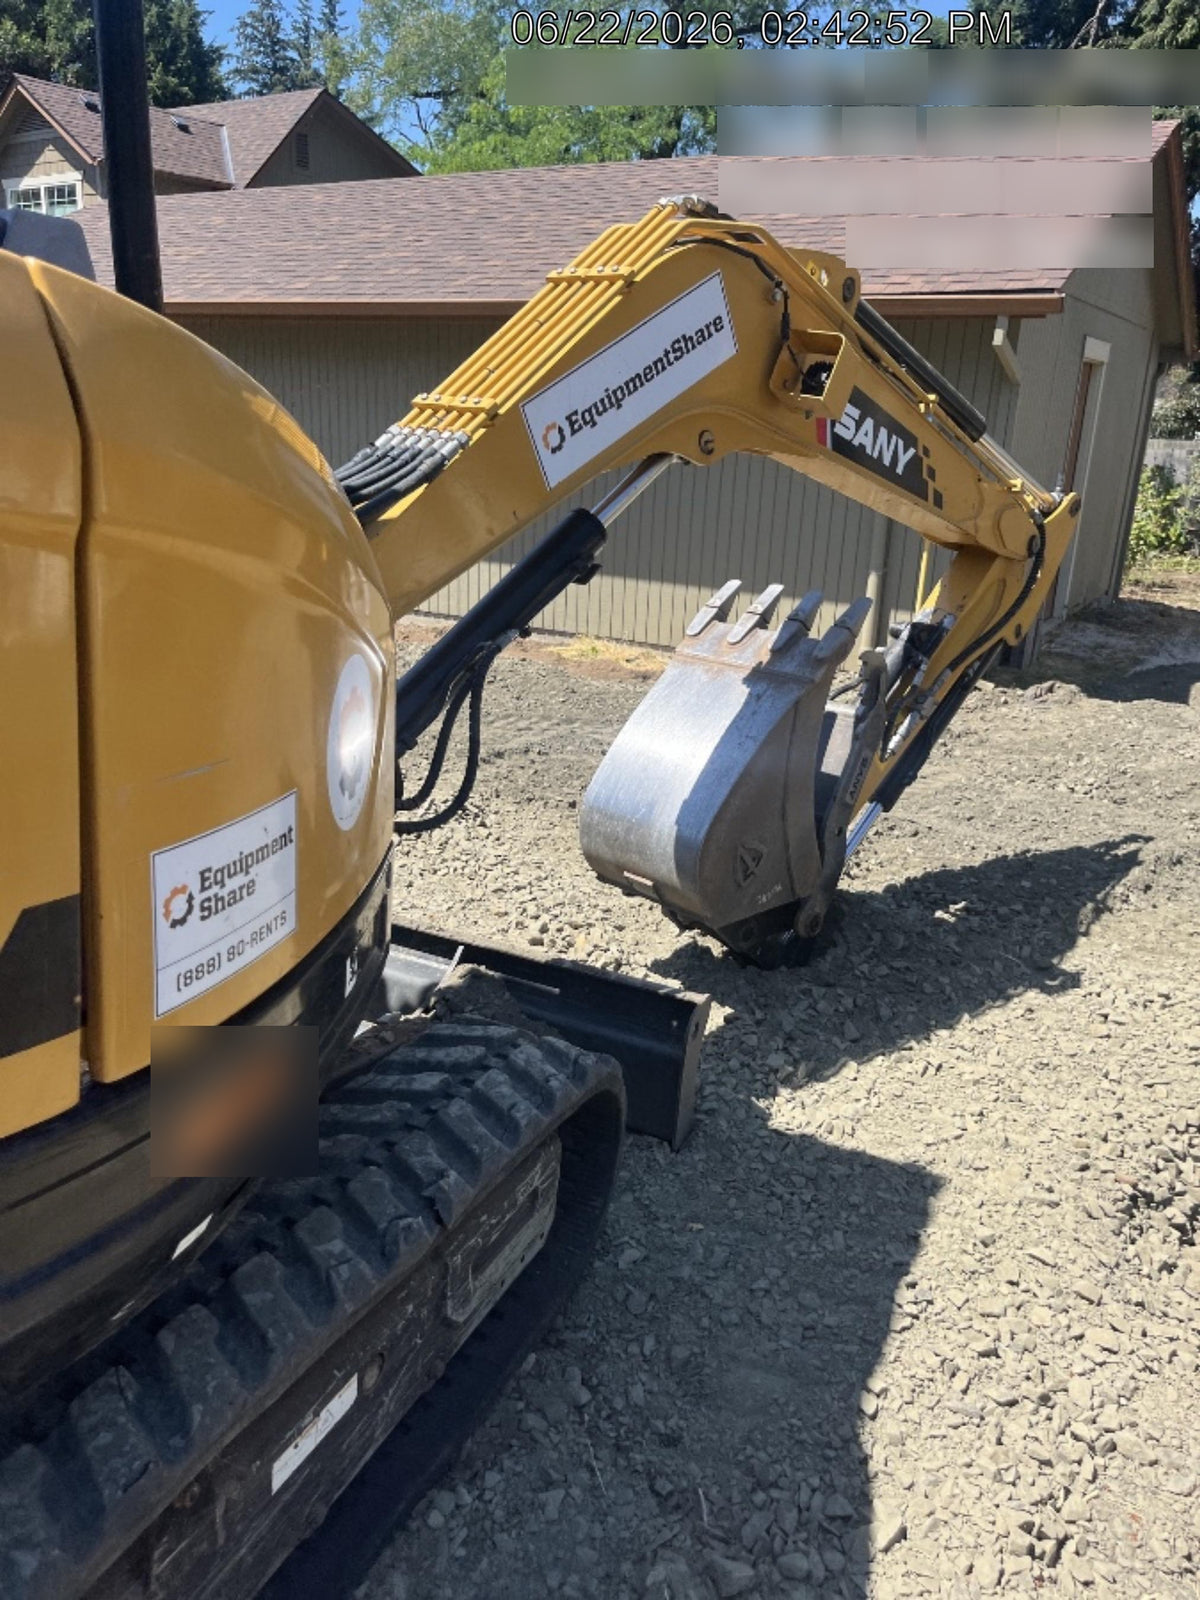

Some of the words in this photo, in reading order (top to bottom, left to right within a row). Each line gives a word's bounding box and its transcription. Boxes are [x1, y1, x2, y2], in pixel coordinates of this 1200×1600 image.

[565, 314, 725, 437] EquipmentShare
[833, 402, 917, 476] SANY
[198, 825, 294, 894] Equipment
[199, 878, 257, 922] Share
[176, 951, 222, 993] (888)
[226, 910, 288, 963] 80-RENTS
